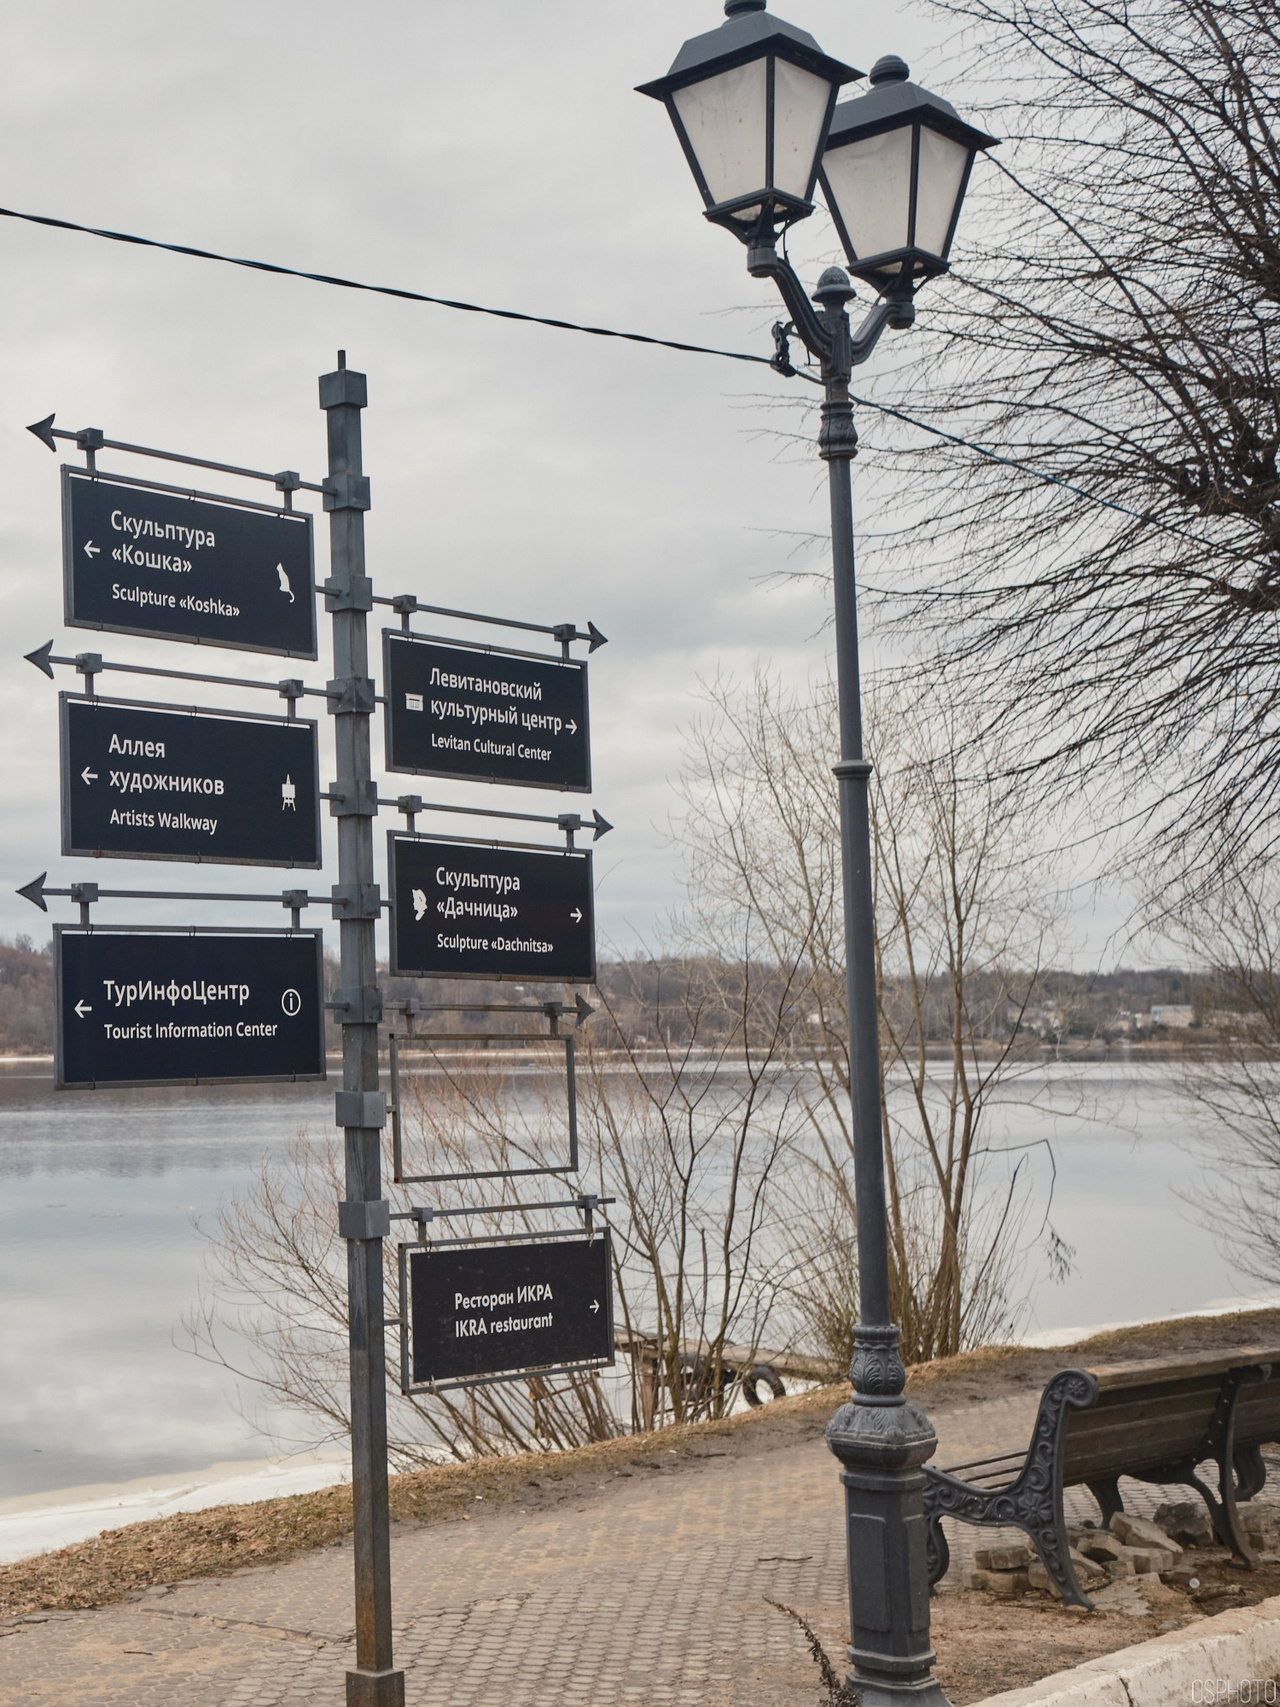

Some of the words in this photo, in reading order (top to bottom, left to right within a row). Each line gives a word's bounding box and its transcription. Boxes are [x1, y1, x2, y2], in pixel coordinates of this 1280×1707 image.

[111, 510, 216, 550] Скульптура
[112, 544, 193, 573] «Кошка»
[112, 583, 176, 608] Sculpture
[179, 598, 240, 617] «Koshka»
[430, 667, 542, 701] Левитановский
[431, 699, 518, 725] культурный
[521, 712, 562, 735] центр
[108, 733, 166, 758] Аллея
[431, 733, 471, 751] Levitan
[473, 738, 515, 757] Cultural
[517, 744, 552, 761] Center
[109, 770, 225, 795] художников
[110, 808, 155, 828] Artists
[158, 812, 218, 835] Walkway
[436, 866, 521, 895] Скульптура
[436, 896, 518, 922] «Дачница»
[437, 933, 489, 953] Sculpture
[491, 936, 554, 953] «Dachnitsa»
[103, 979, 250, 1007] ТурИнфоЦентр
[104, 1022, 152, 1039] Tourist
[155, 1022, 233, 1039] Information
[236, 1021, 278, 1037] Center
[455, 1291, 514, 1311] Ресторан
[516, 1283, 553, 1303] ИКРА
[455, 1319, 488, 1338] IKRA
[490, 1312, 553, 1334] restaurant
